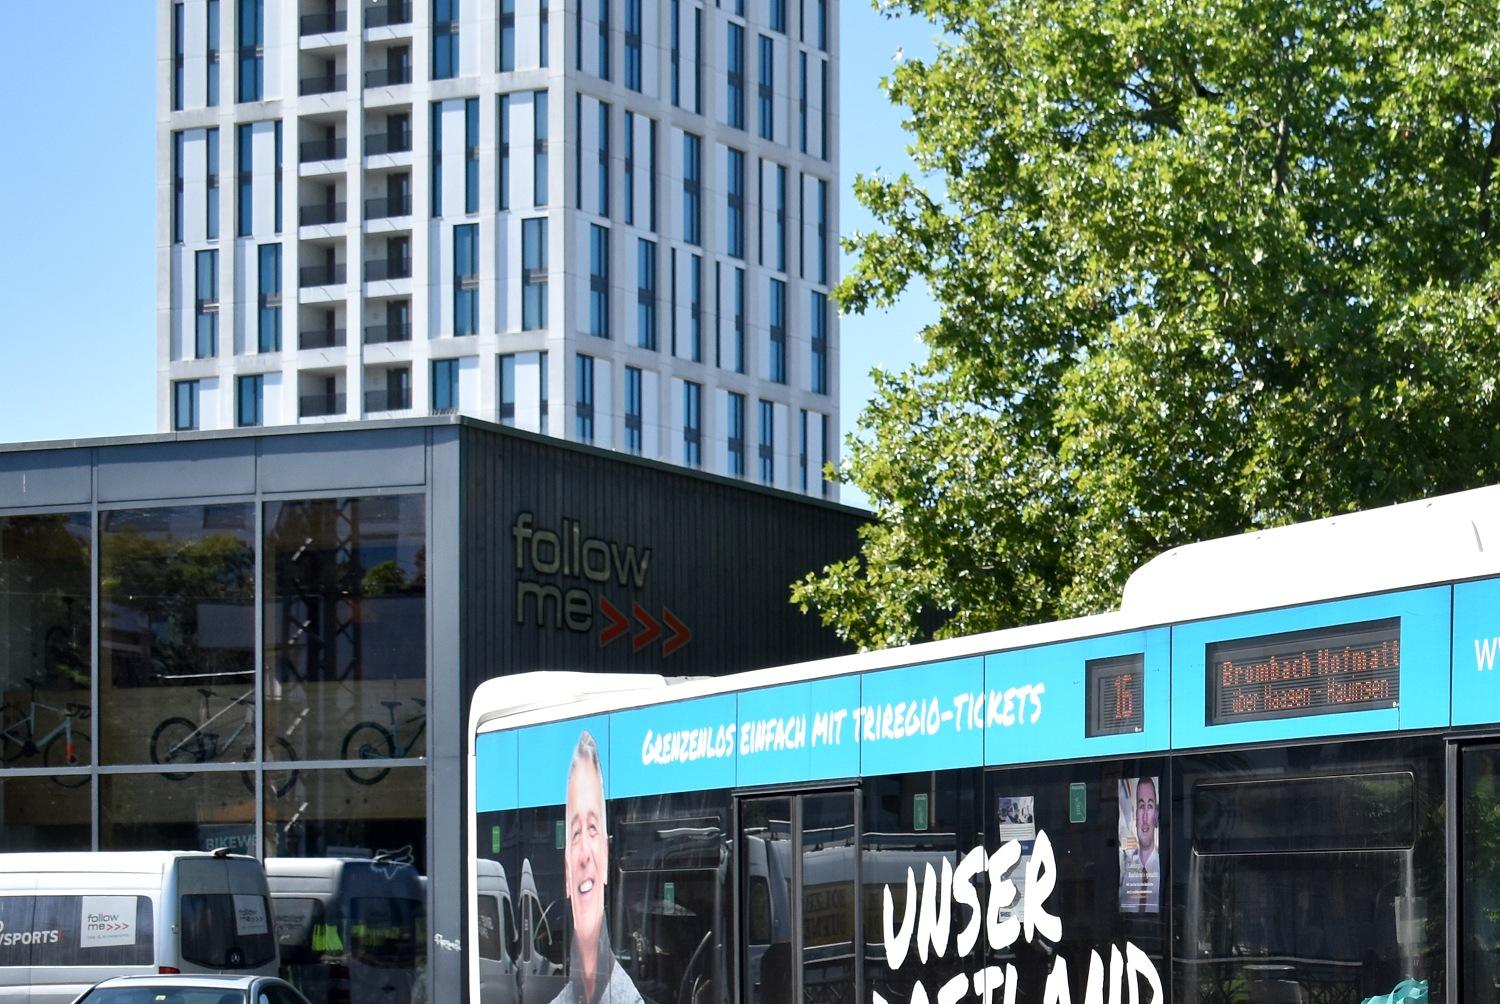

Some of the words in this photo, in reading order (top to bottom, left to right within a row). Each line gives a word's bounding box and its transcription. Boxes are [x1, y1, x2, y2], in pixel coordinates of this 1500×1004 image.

[512, 512, 652, 588] follow
[516, 580, 593, 633] me
[1222, 651, 1312, 687] Brombach
[1317, 639, 1399, 675] Hofmatt
[1114, 673, 1133, 719] 16
[641, 723, 736, 766] GRENZENLOS
[739, 713, 806, 756] EINFACH
[811, 708, 848, 747] MIT
[854, 682, 1046, 743] TRIREGIO-TICKETS
[87, 913, 119, 923] follow
[883, 828, 1063, 970] UNSER
[87, 923, 106, 931] me
